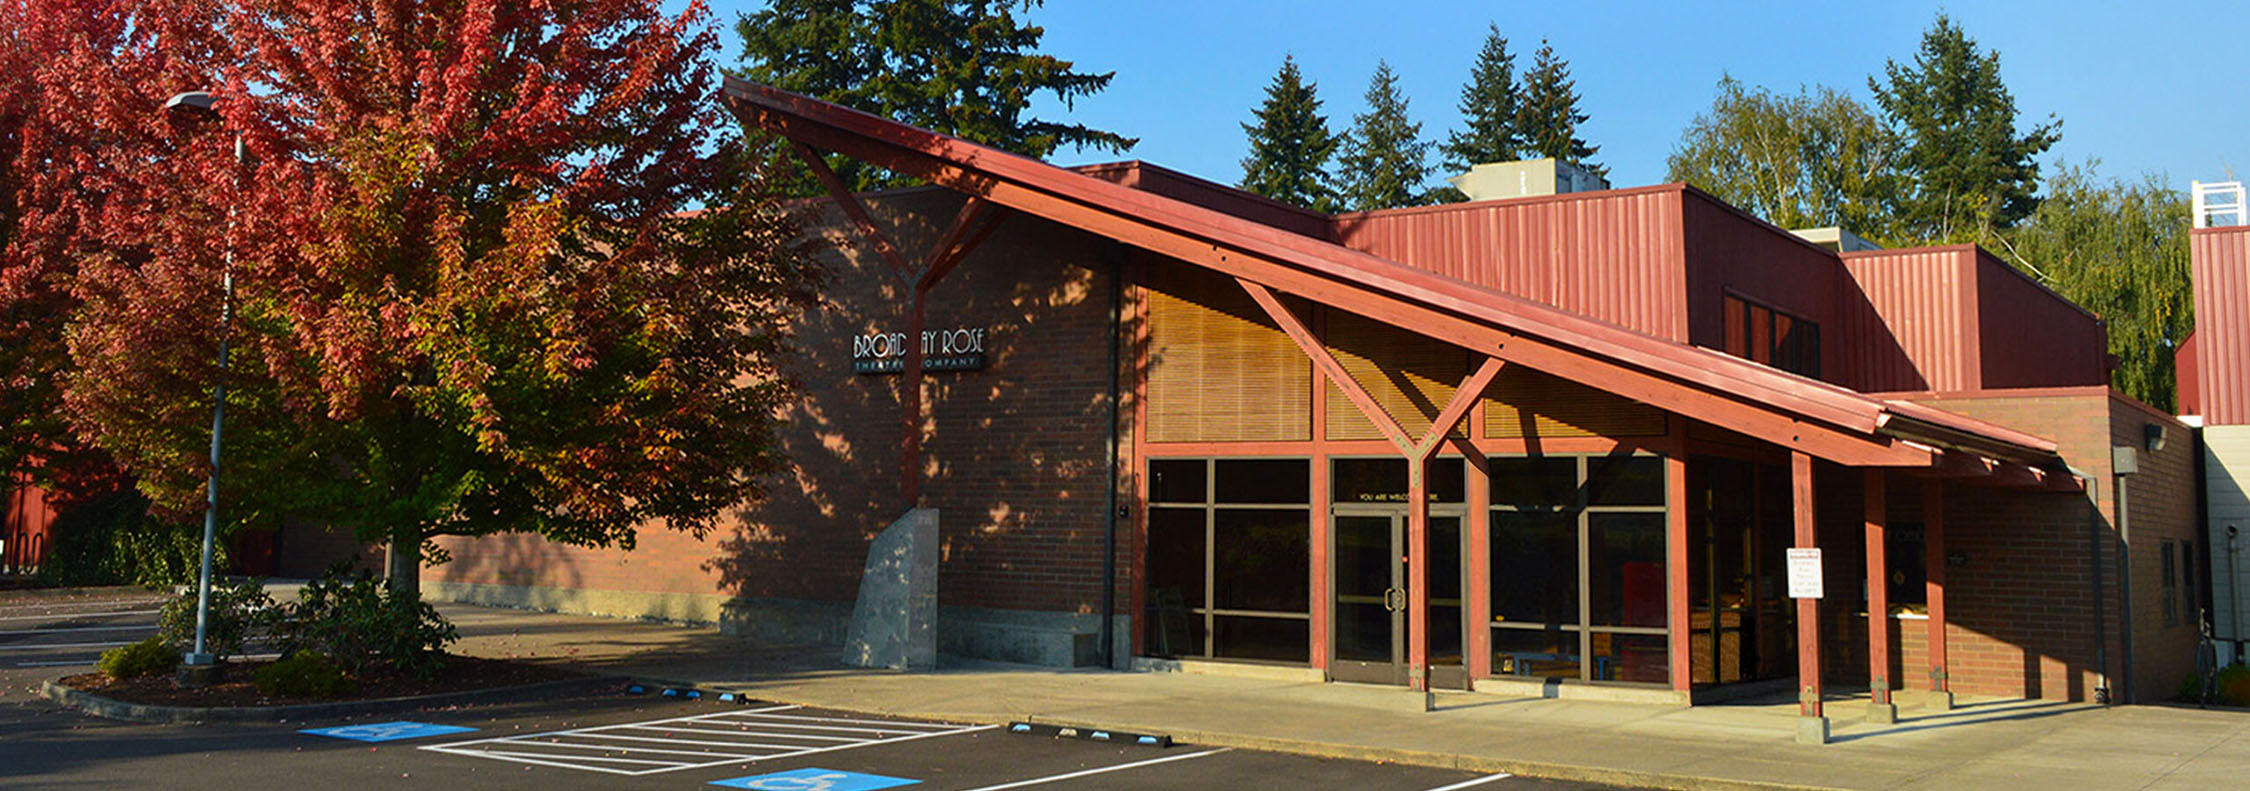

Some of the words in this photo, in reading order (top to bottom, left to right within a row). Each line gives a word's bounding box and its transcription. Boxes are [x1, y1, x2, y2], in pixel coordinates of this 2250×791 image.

[853, 331, 937, 358] BROADAY
[942, 328, 984, 354] ROSE
[924, 357, 976, 368] OMPANY
[1360, 493, 1374, 501] YOU
[1375, 493, 1387, 501] ARE
[1389, 493, 1410, 501] WELCO
